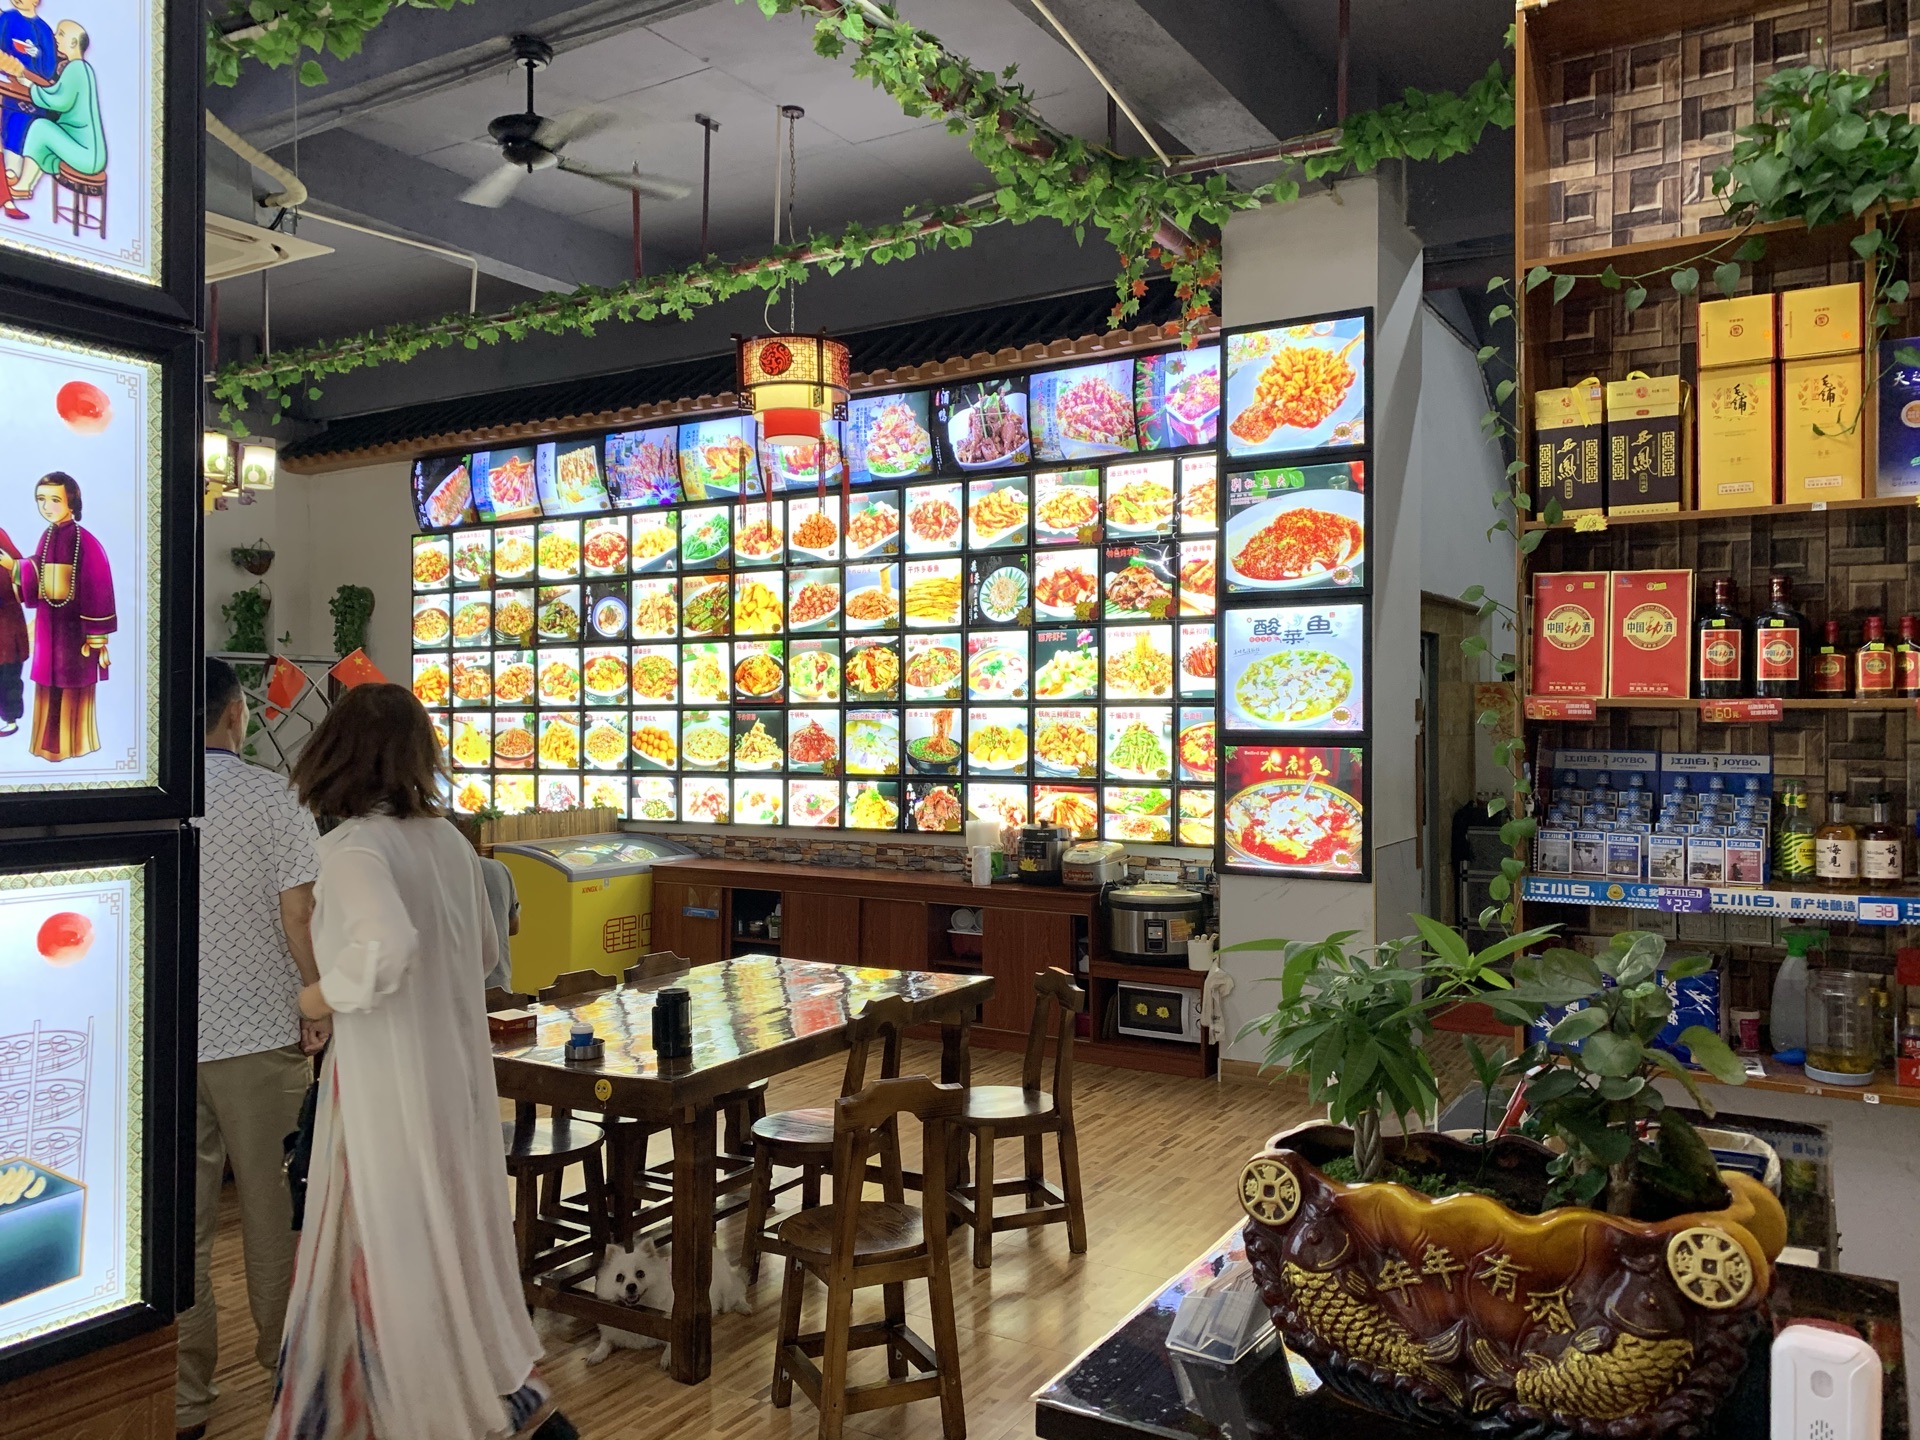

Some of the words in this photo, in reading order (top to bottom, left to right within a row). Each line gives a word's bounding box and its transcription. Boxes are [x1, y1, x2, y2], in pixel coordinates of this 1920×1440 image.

[1254, 615, 1333, 645] 酸菜鱼
[1260, 754, 1330, 776] 水煮鱼
[1826, 843, 1842, 868] 梅见
[1529, 881, 1591, 897] 江小白
[1790, 897, 1857, 913] 原产地酿造
[1875, 905, 1895, 918] 38
